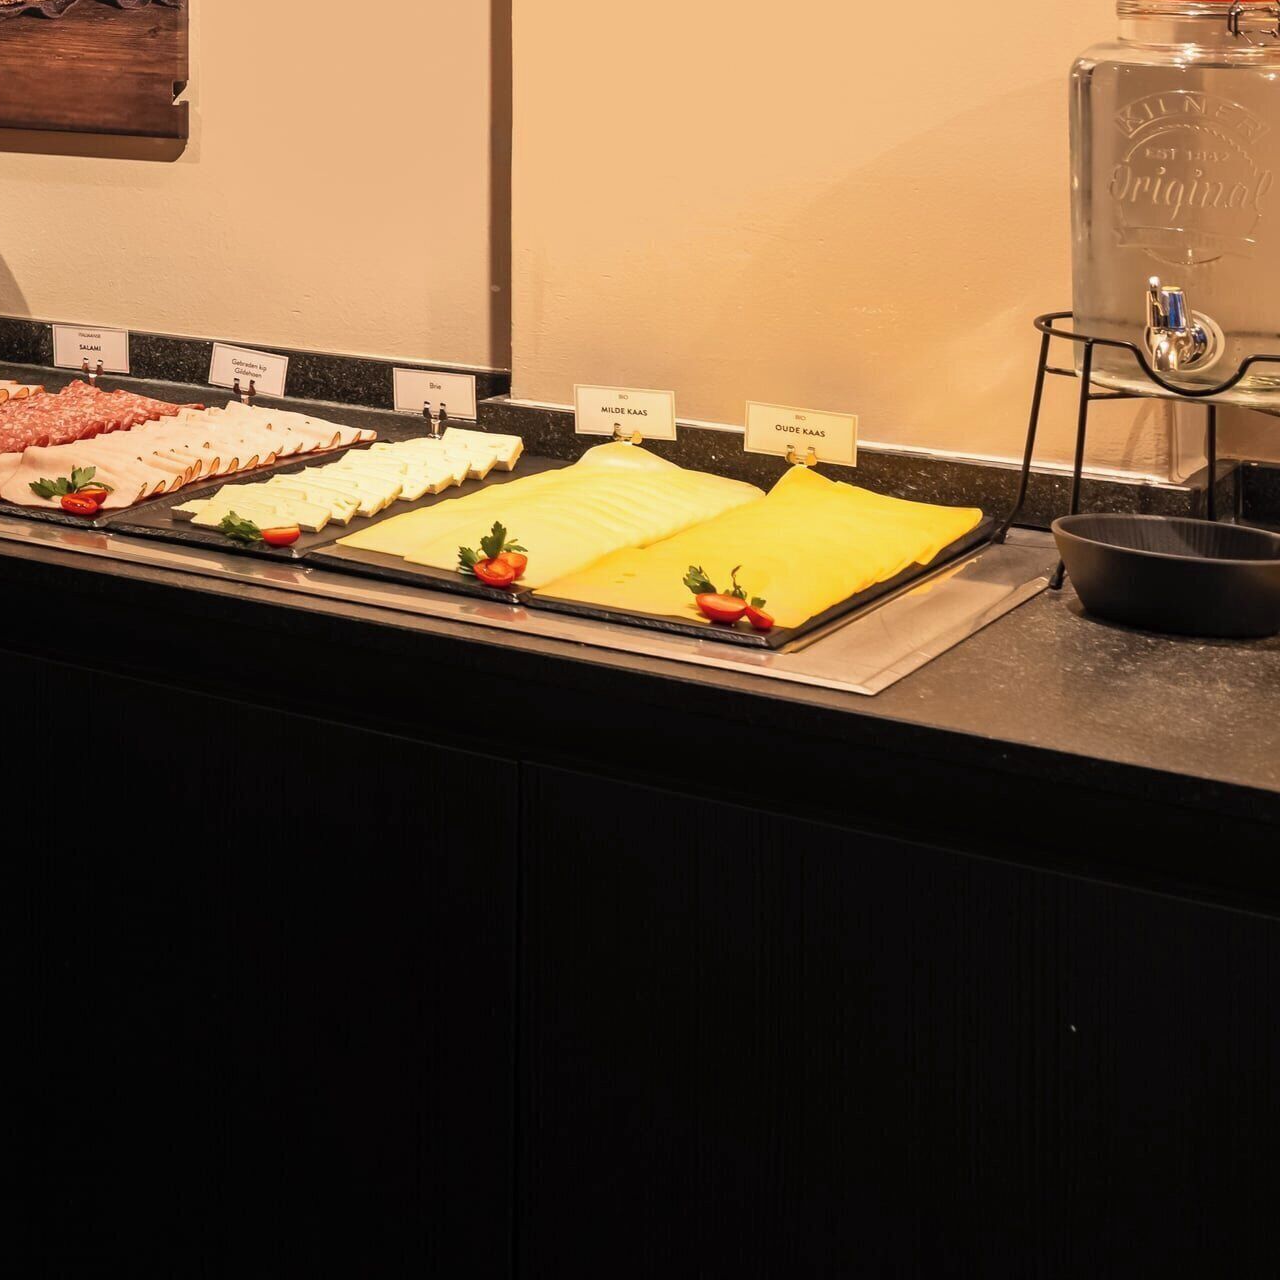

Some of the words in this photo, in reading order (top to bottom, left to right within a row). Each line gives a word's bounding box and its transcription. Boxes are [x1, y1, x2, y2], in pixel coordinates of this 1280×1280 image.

[1109, 164, 1274, 221] Original
[79, 344, 102, 352] SALAMI
[231, 358, 258, 370] Gebraden
[258, 363, 267, 372] kip
[429, 381, 442, 390] Brie
[601, 406, 626, 416] MILDE
[627, 407, 648, 417] KAAS
[775, 424, 801, 434] OUDE
[802, 427, 826, 438] KAAS
